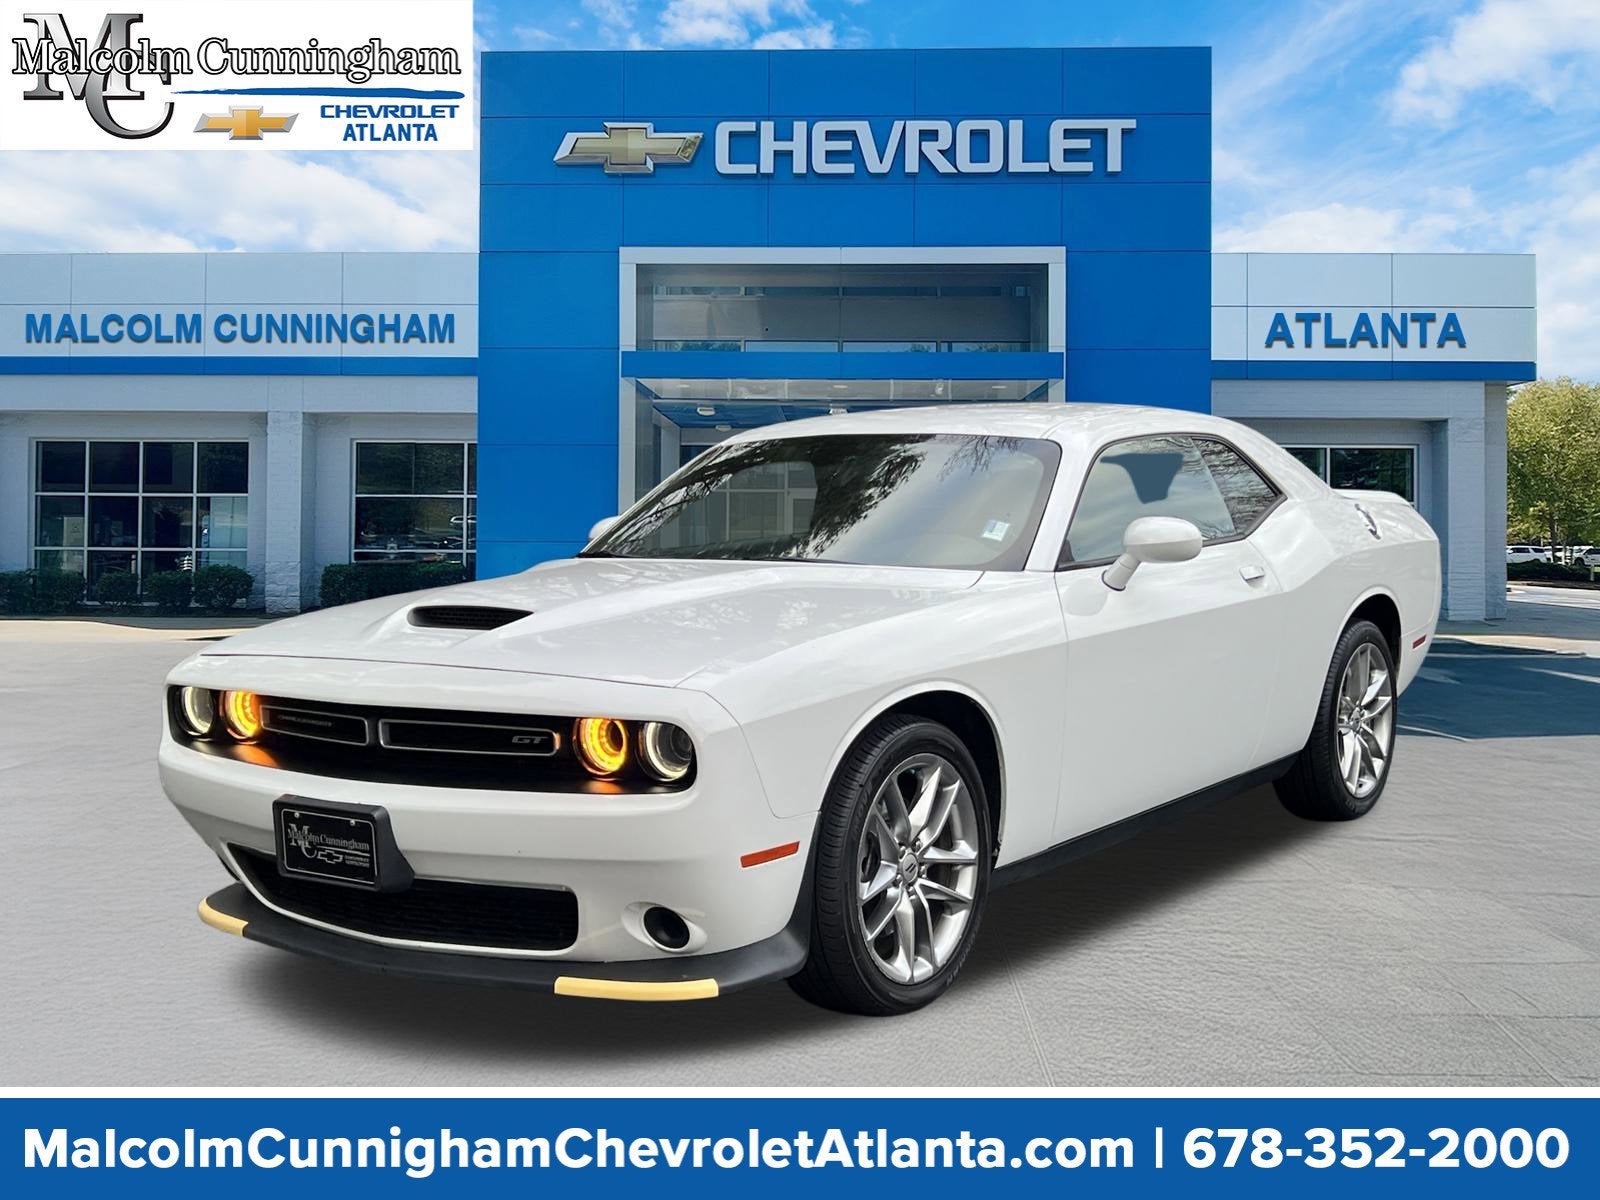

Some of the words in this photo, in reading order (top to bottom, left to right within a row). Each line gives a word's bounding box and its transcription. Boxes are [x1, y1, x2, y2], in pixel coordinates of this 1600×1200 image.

[714, 119, 1137, 175] CHEVROLET
[25, 313, 201, 344] MALCOLM
[213, 313, 456, 344] CUNNINGHAM
[1265, 312, 1467, 348] ATLANTA
[511, 735, 548, 745] GT
[320, 833, 370, 852] Cunningham
